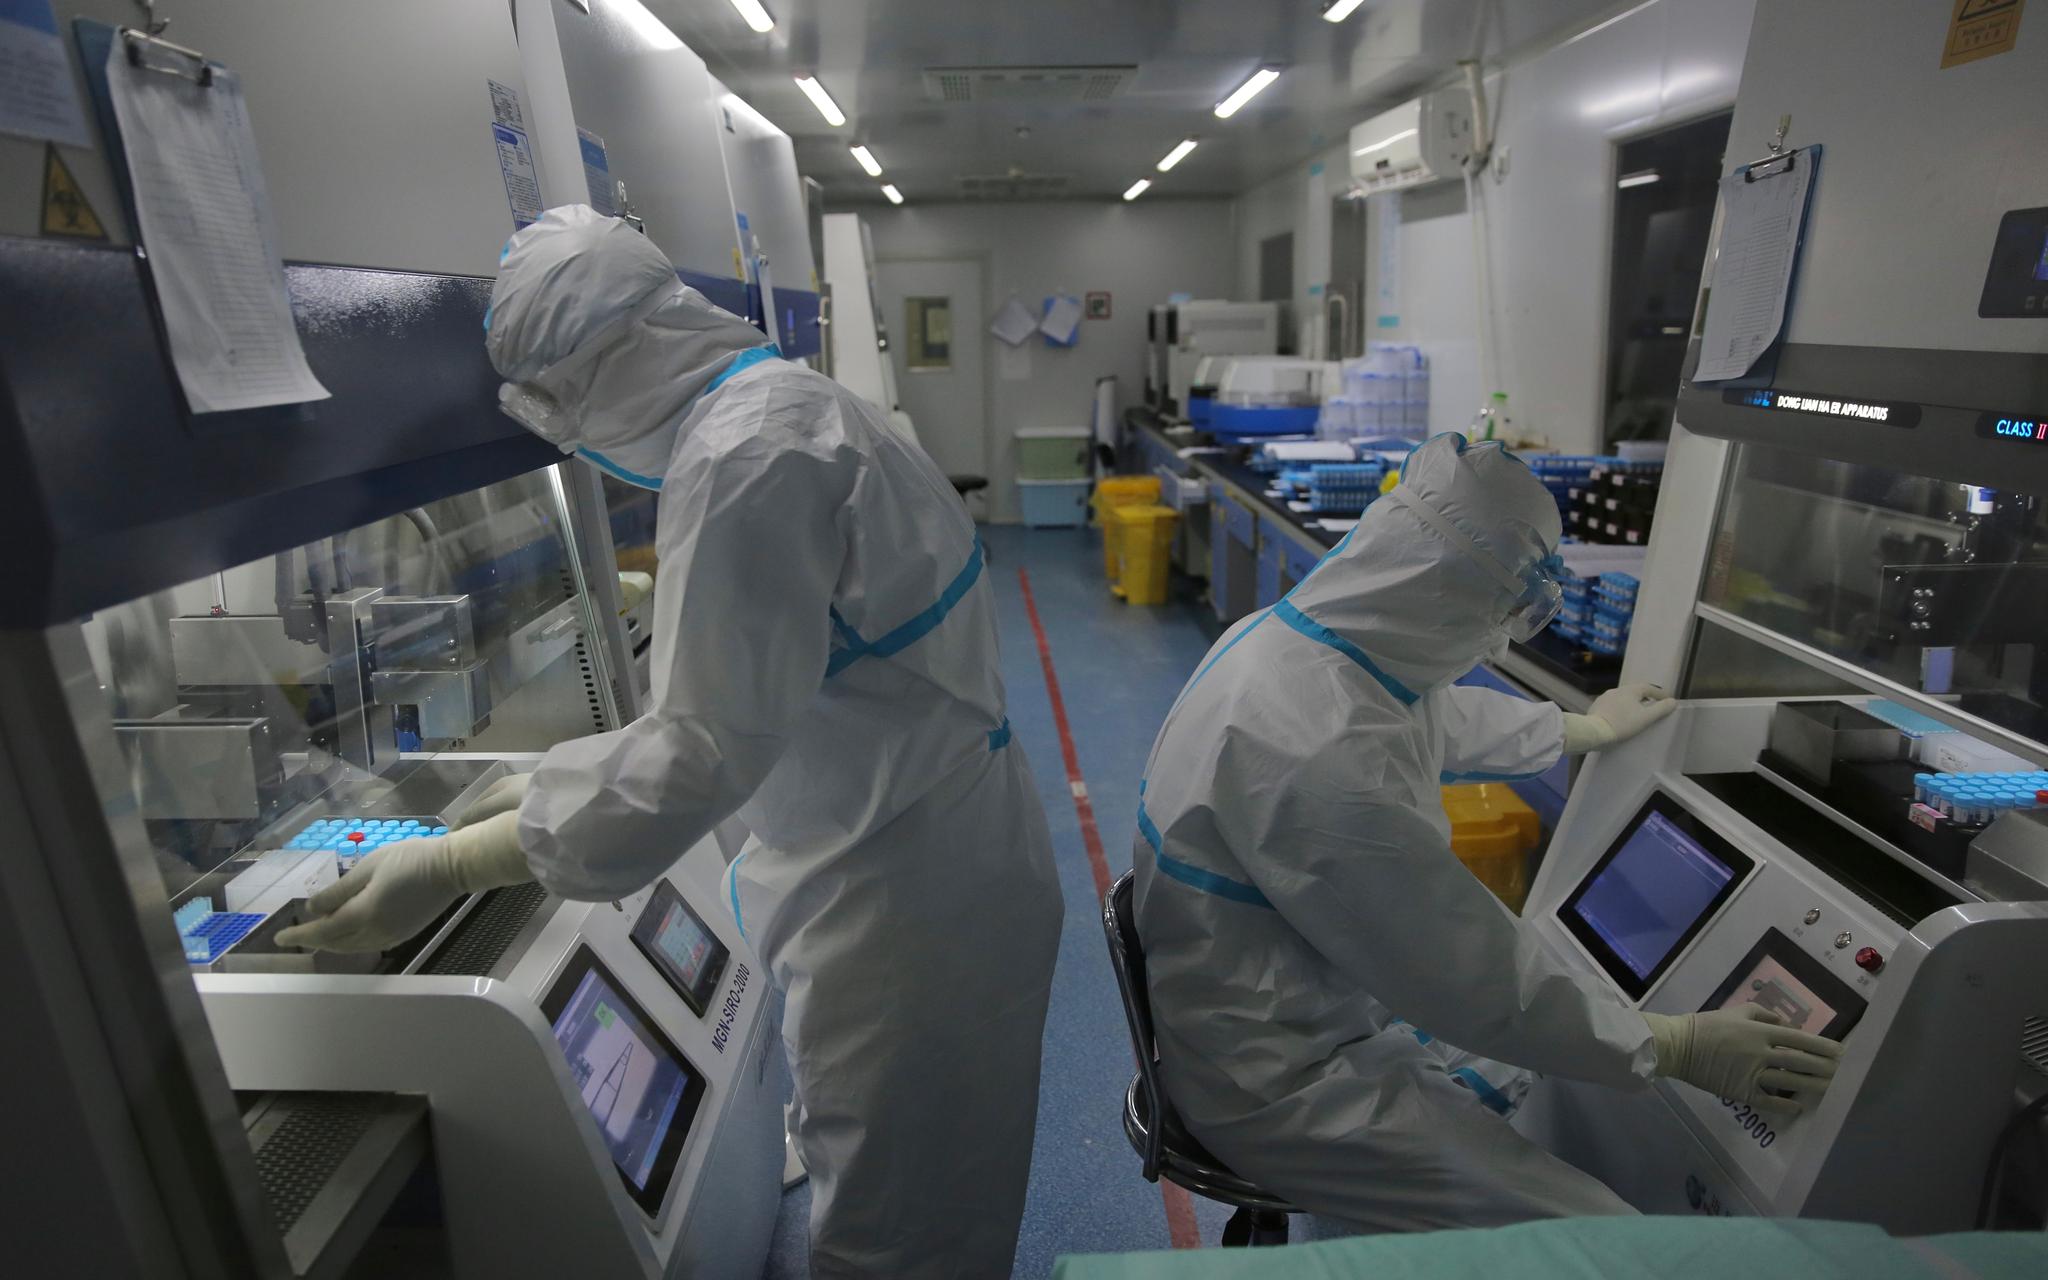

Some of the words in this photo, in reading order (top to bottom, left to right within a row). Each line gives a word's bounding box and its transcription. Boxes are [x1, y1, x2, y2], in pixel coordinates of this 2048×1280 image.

[1777, 395, 1801, 409] DONG
[1801, 398, 1819, 412] LIAN
[1818, 400, 1830, 413] HA
[1830, 401, 1841, 414] ER
[1841, 403, 1889, 420] APPARATUS
[1996, 419, 2034, 437] CLASS
[711, 963, 750, 1054] MGN-SIRO-2000
